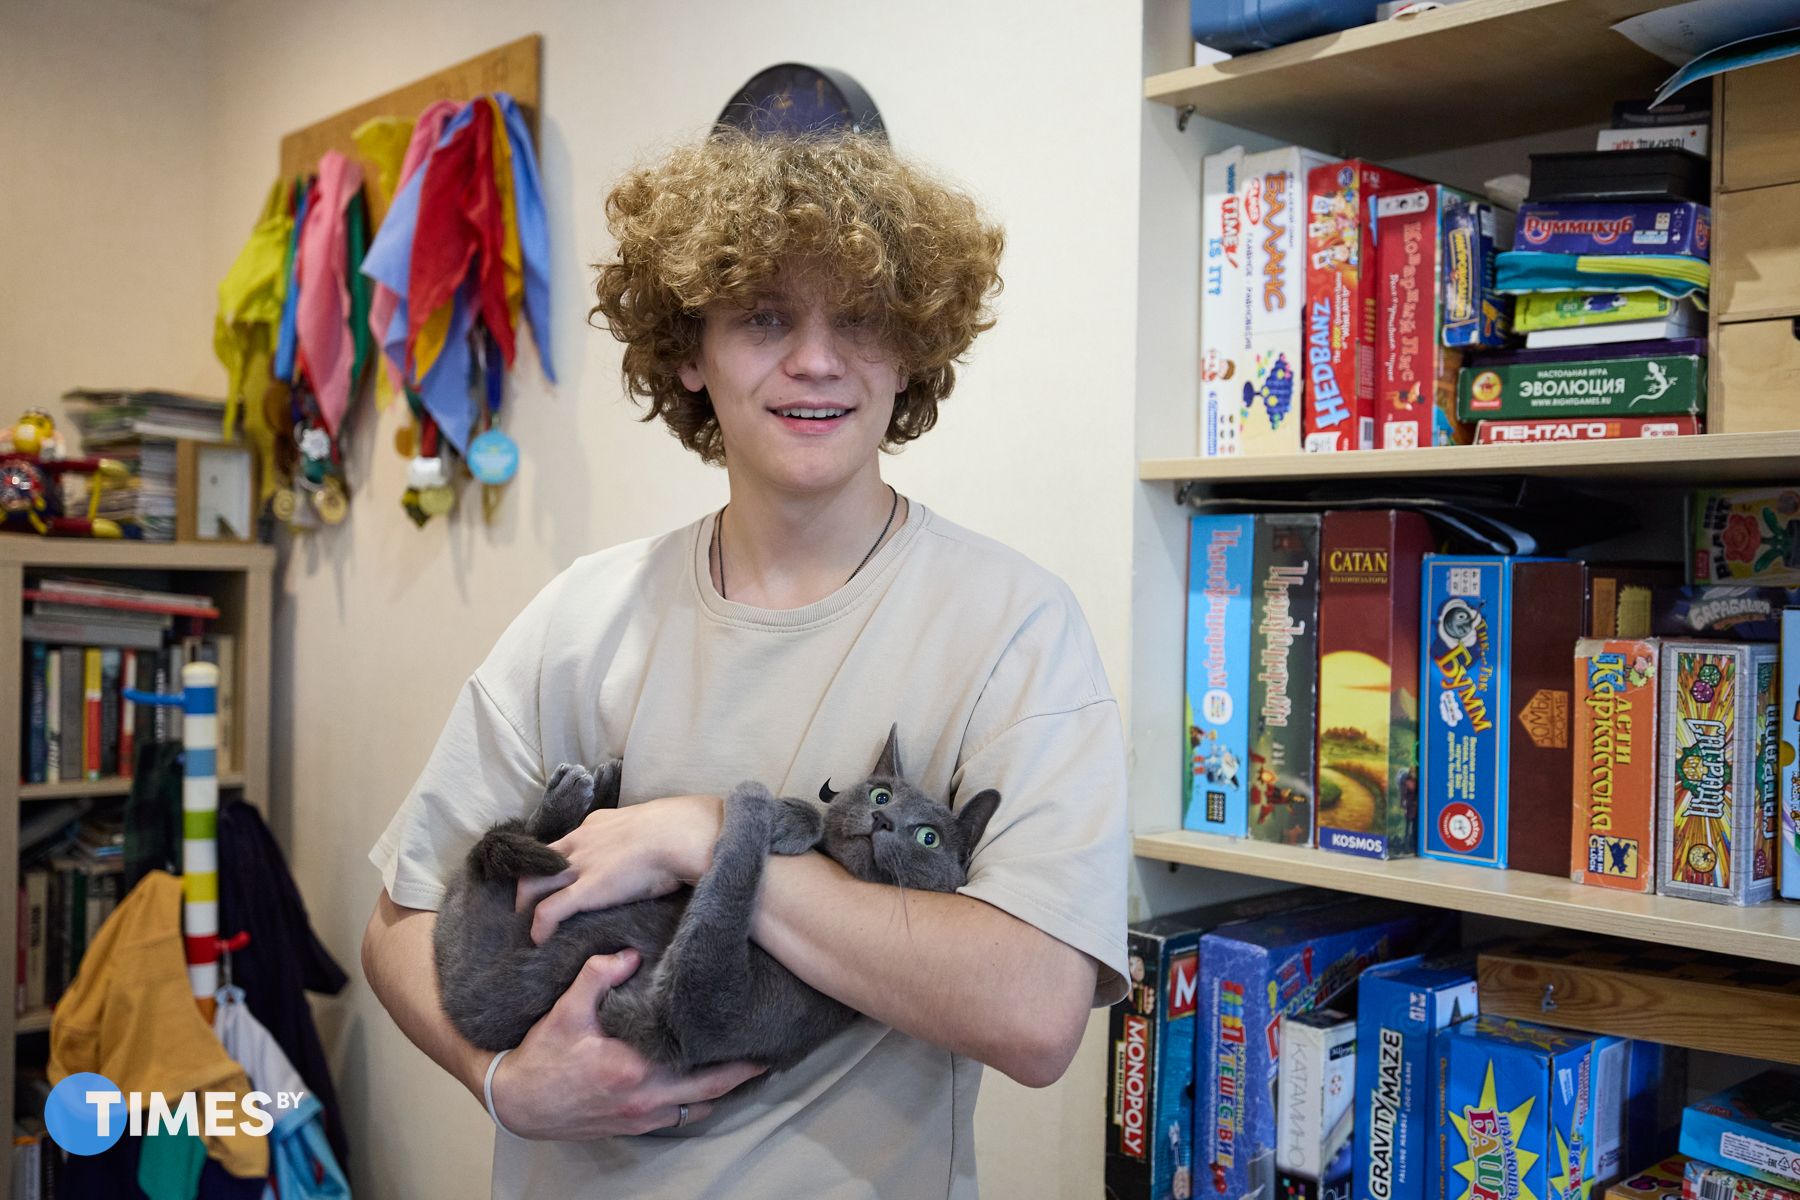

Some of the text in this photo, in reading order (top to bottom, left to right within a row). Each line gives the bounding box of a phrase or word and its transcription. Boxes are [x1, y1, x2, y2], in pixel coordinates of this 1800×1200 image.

[1263, 173, 1287, 313] БАЛАНС
[1525, 216, 1633, 245] Руммикуб
[1208, 238, 1222, 295] IS IT?
[1399, 222, 1422, 381] Коварный Лис
[1311, 298, 1351, 429] HEDBANZ
[1519, 378, 1626, 398] ЭВОЛЮЦИЯ
[1537, 367, 1608, 379] НАСТОЛЬНАЯ ИГРА
[1490, 422, 1607, 441] ПЕНТАГО
[1329, 550, 1388, 574] CATAN
[1529, 691, 1553, 746] ЗОМБИ
[1681, 718, 1727, 818] САГРАДА
[1332, 832, 1383, 853] KOSMOS
[1464, 809, 1481, 847] Piatnik
[1588, 835, 1600, 871] GLÜCK
[1596, 837, 1605, 861] HANS
[1124, 1020, 1146, 1154] MONOPOLY
[1217, 1026, 1246, 1169] ПУТЕШЕСТВИЕ
[1288, 1042, 1308, 1168] КАТАМИНО
[1371, 1031, 1401, 1198] GRAVITY MAZE
[1403, 1061, 1413, 1112] LOGIC GAME
[1398, 1113, 1408, 1183] FALLING MARBLE
[1498, 1115, 1519, 1200] ПАДАЮЩА
